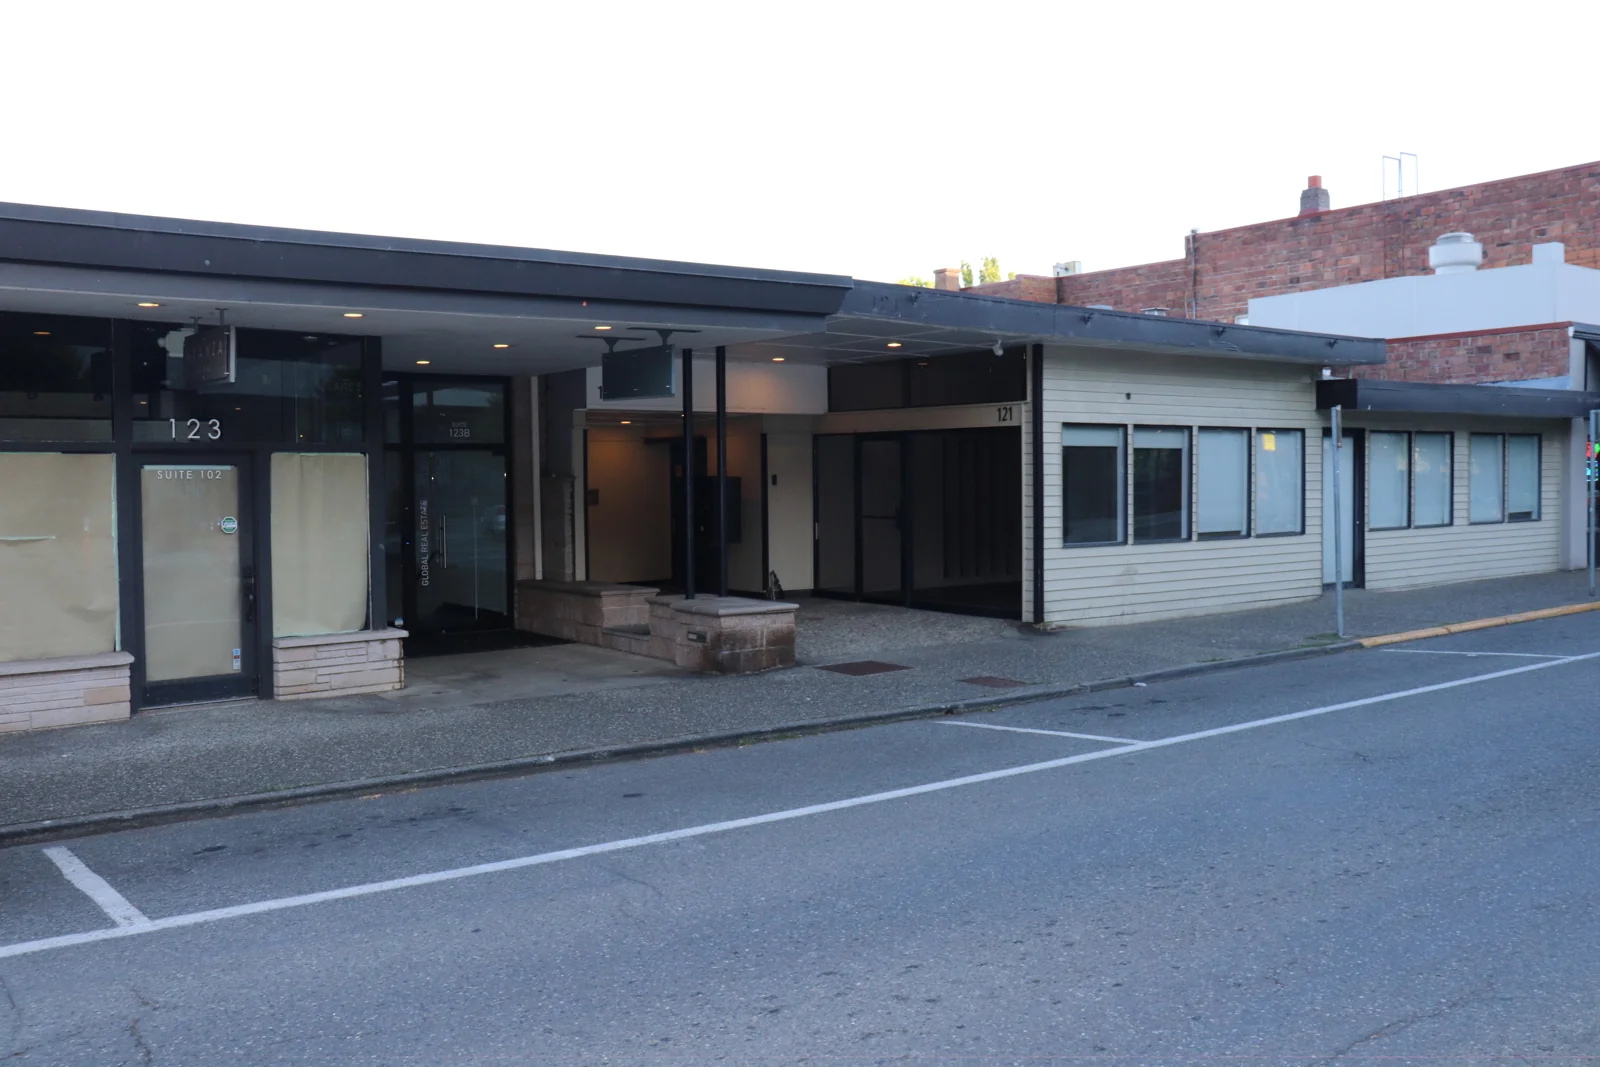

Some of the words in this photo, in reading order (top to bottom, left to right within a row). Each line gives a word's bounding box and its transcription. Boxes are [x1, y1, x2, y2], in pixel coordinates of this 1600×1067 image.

[997, 406, 1013, 422] 121
[169, 418, 222, 439] 123
[448, 428, 470, 438] 123B
[157, 470, 193, 479] SUITE
[200, 470, 222, 479] 102
[420, 499, 428, 530] ESTATE
[421, 531, 429, 553] REAL
[421, 554, 429, 586] GLOBAL
